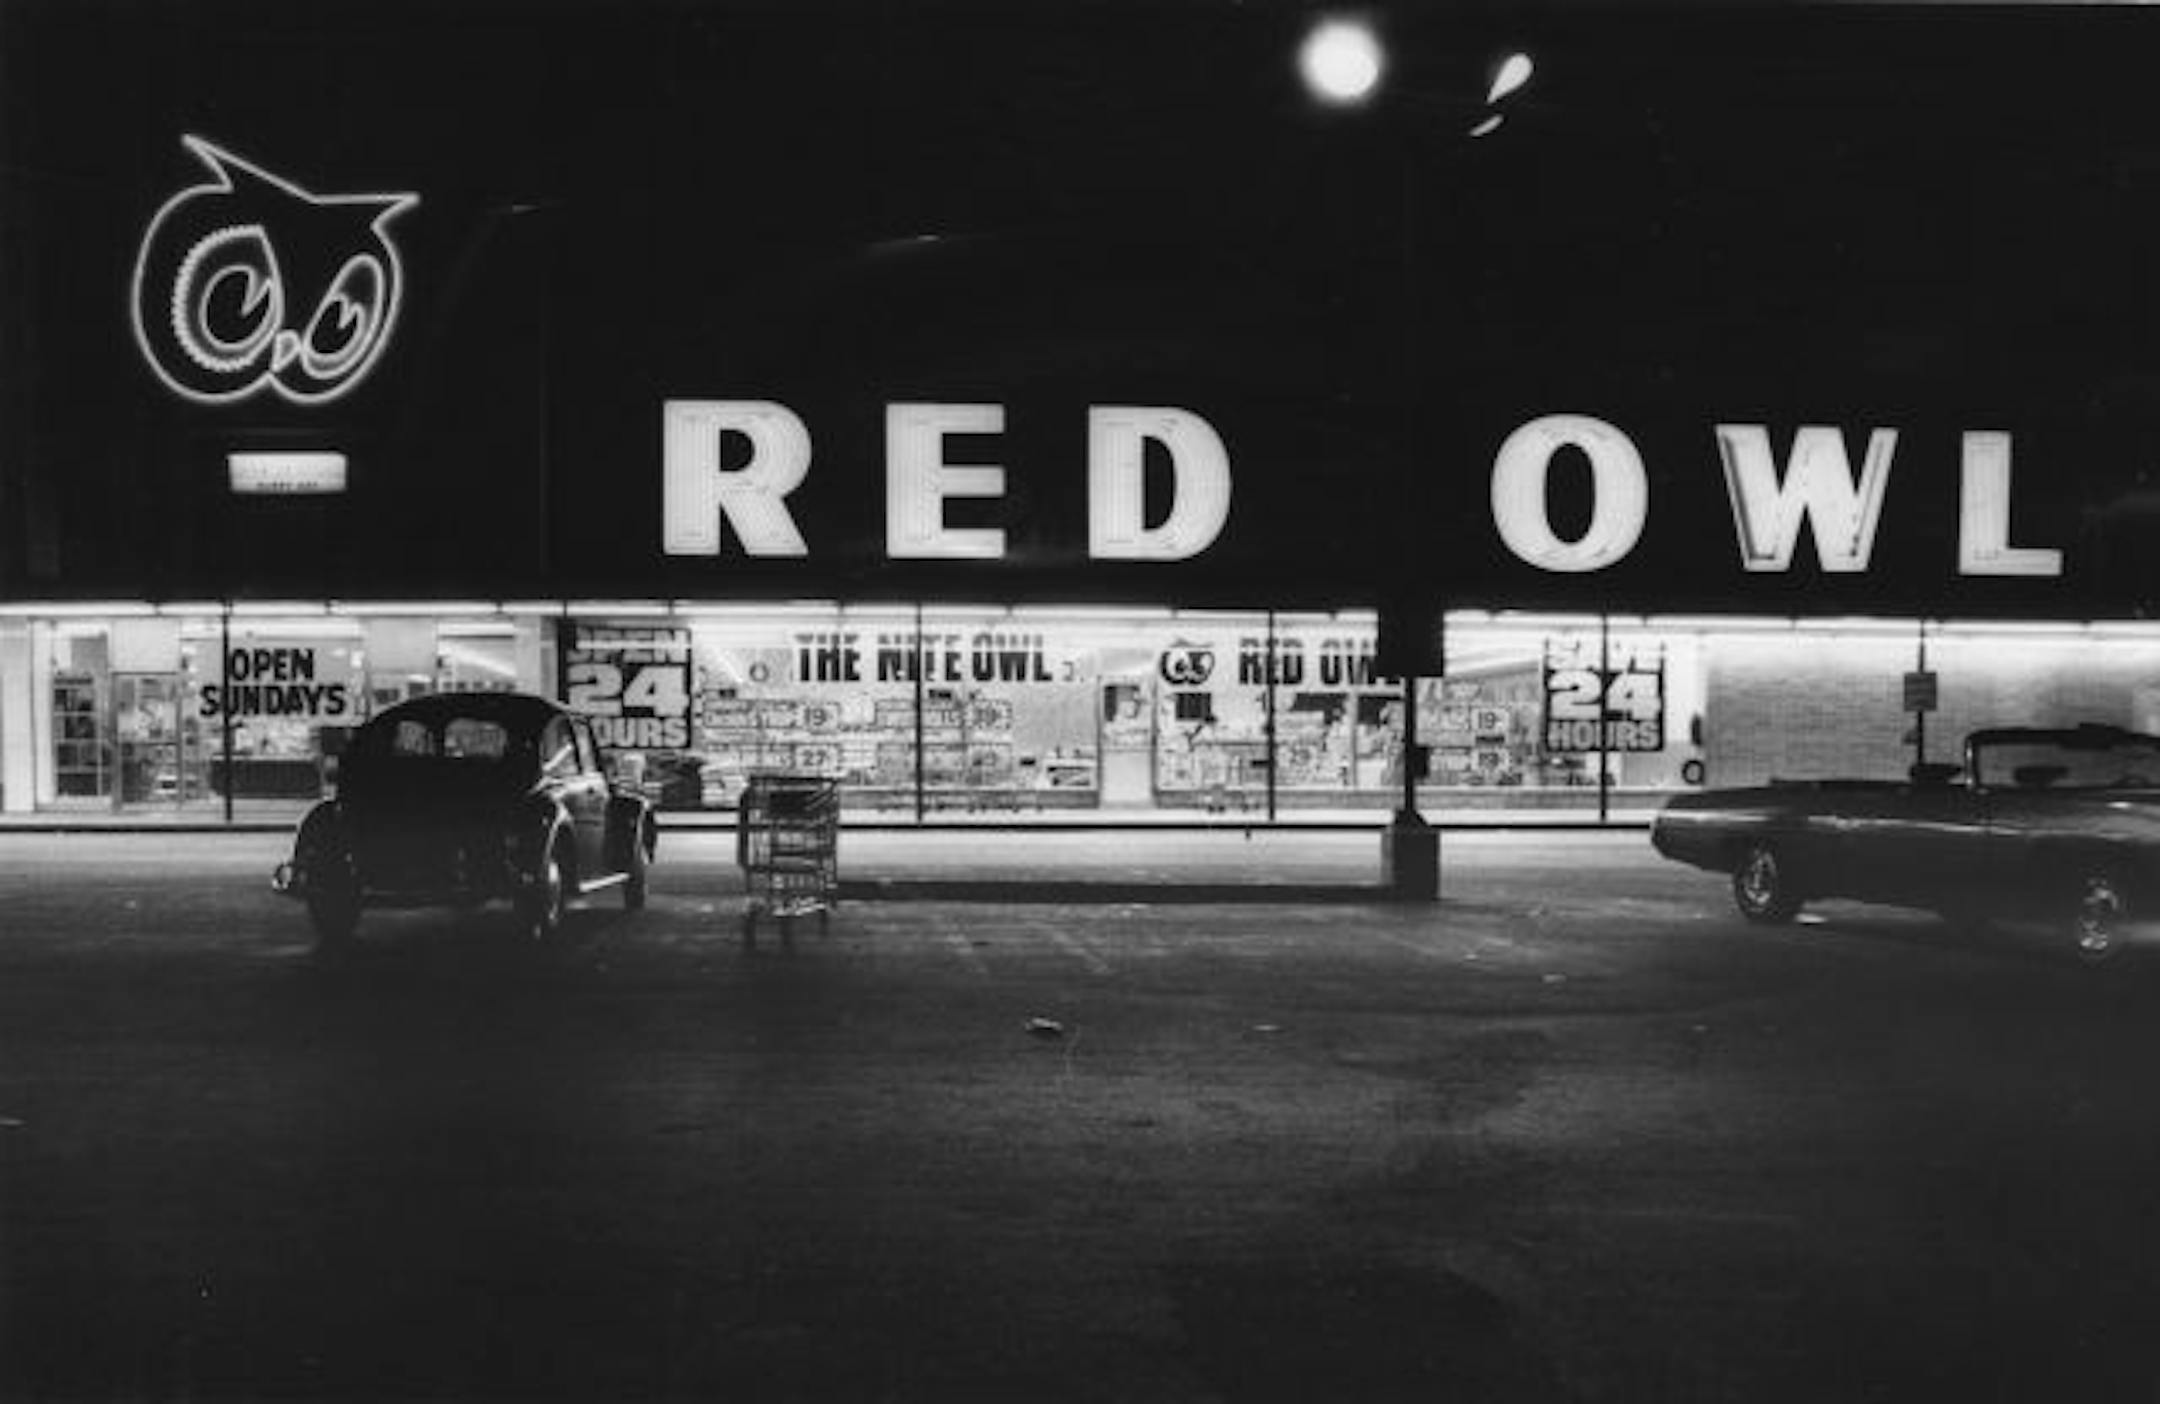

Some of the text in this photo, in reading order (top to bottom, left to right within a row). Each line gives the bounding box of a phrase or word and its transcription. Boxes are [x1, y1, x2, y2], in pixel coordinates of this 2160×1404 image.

[663, 400, 2063, 576] RED OWL
[231, 648, 315, 680] OPEN
[794, 634, 1053, 682] THE NITE OWL
[1239, 637, 1401, 686] RED OW
[199, 685, 347, 717] SUNDAYS
[568, 663, 687, 716] 24
[1549, 670, 1660, 720] 24
[584, 717, 687, 748] OURS
[1549, 720, 1660, 750] HOURS
